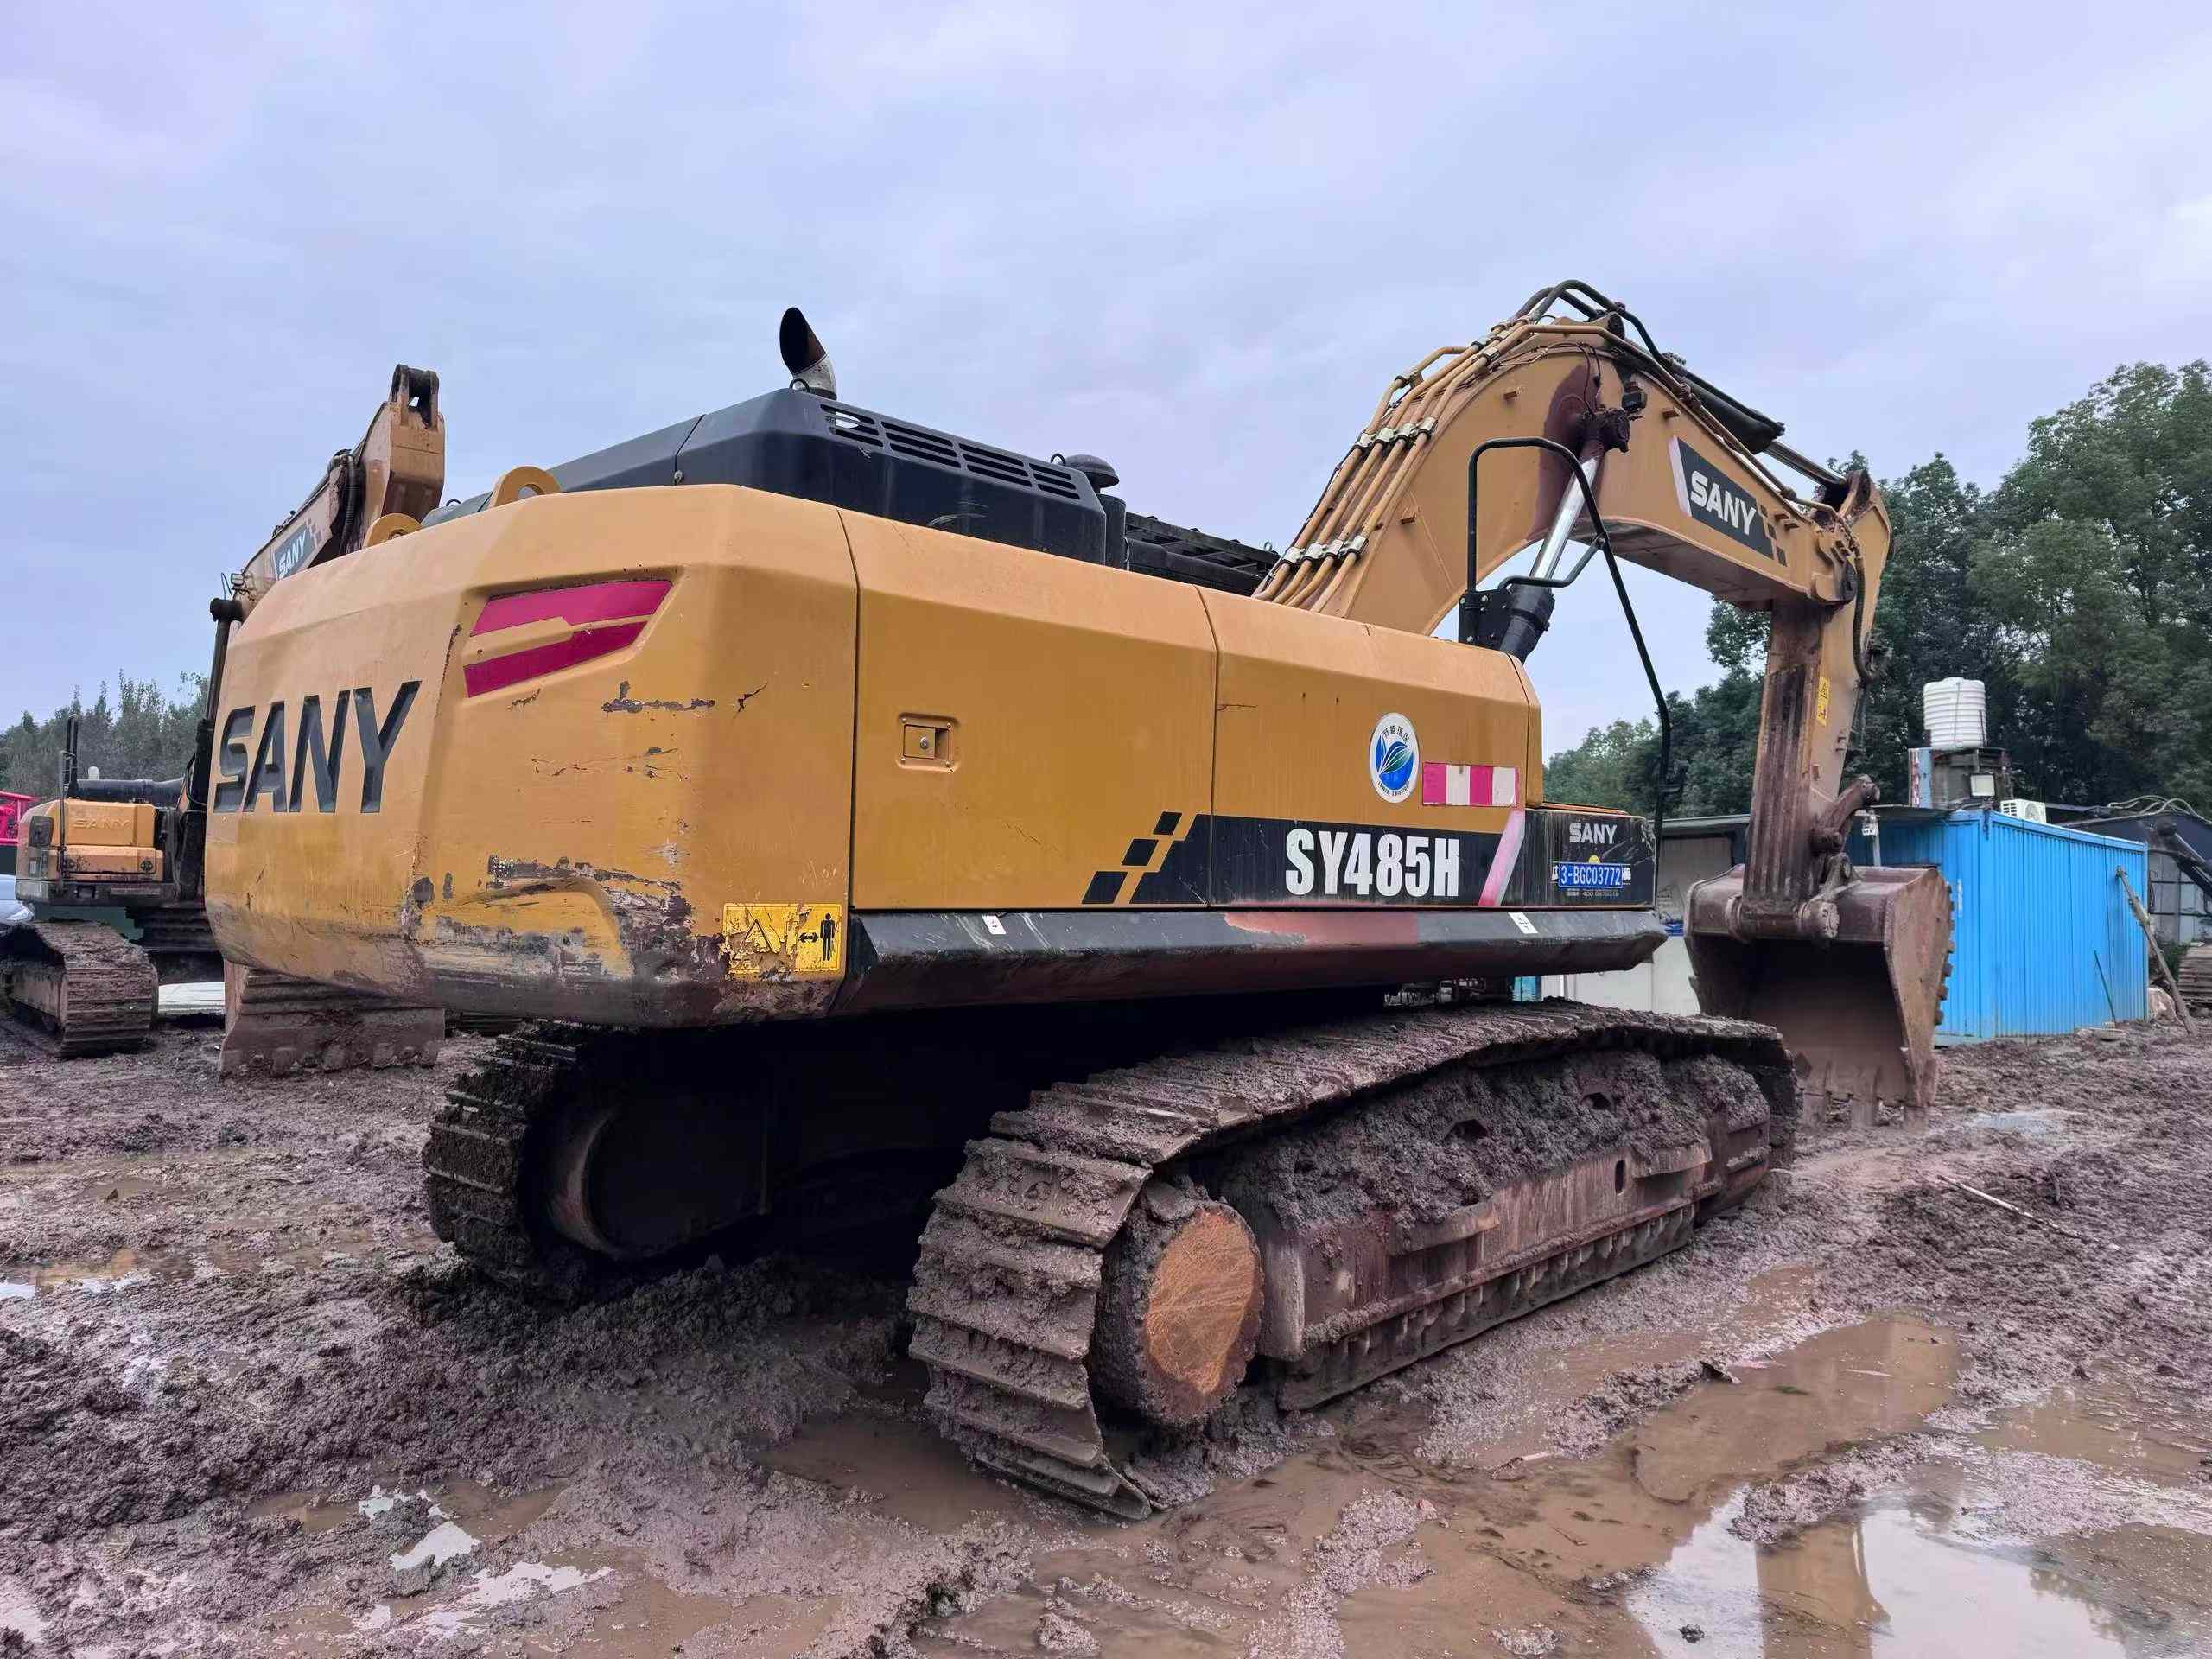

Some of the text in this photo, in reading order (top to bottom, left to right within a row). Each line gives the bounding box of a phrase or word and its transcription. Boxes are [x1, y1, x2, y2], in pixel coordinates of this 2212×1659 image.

[1690, 470, 1757, 536] SANY
[278, 529, 307, 579] SANY
[213, 679, 423, 814] SANY
[73, 817, 132, 830] SANY
[1569, 822, 1618, 844] SANY
[1285, 828, 1459, 898] SY485H
[1560, 865, 1621, 886] 3-BGC03772
